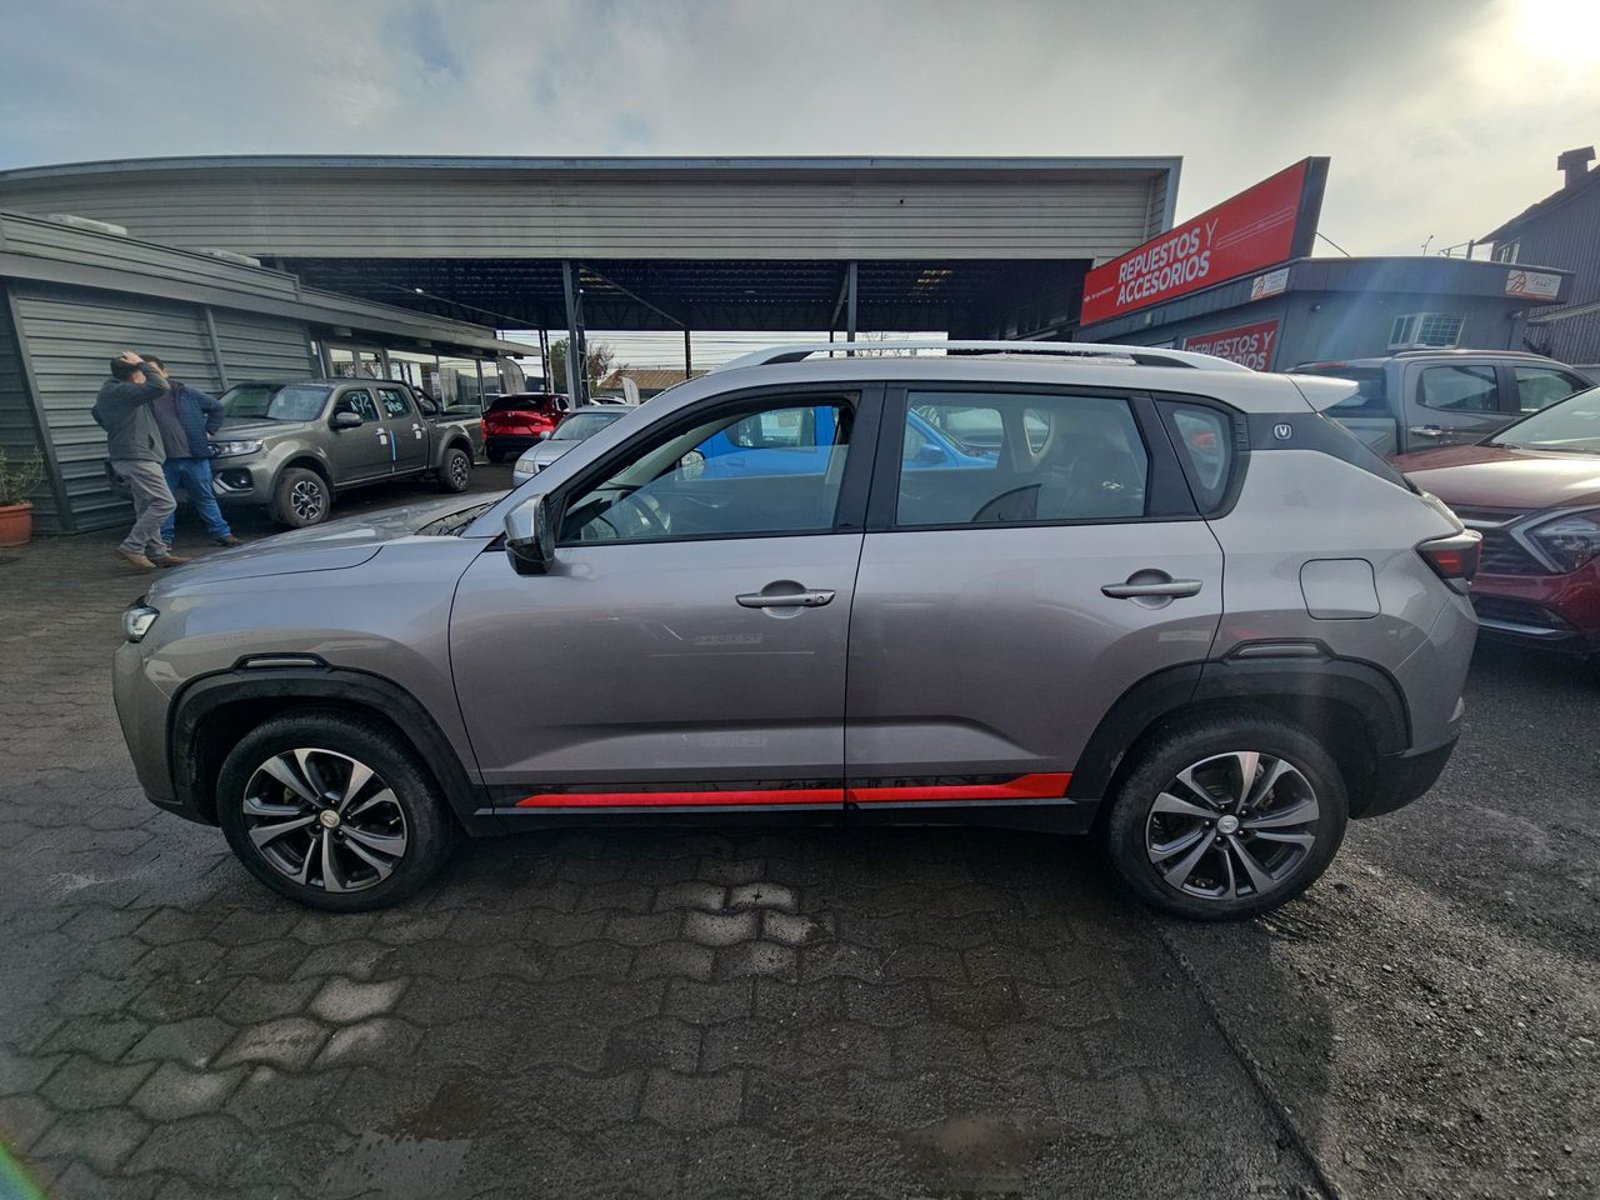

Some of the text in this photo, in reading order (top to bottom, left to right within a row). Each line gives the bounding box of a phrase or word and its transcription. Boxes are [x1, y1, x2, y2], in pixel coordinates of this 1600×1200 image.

[1116, 250, 1211, 306] ACCESORIOS
[1118, 218, 1219, 284] REPUESTOS Y
[1263, 330, 1275, 350] Y
